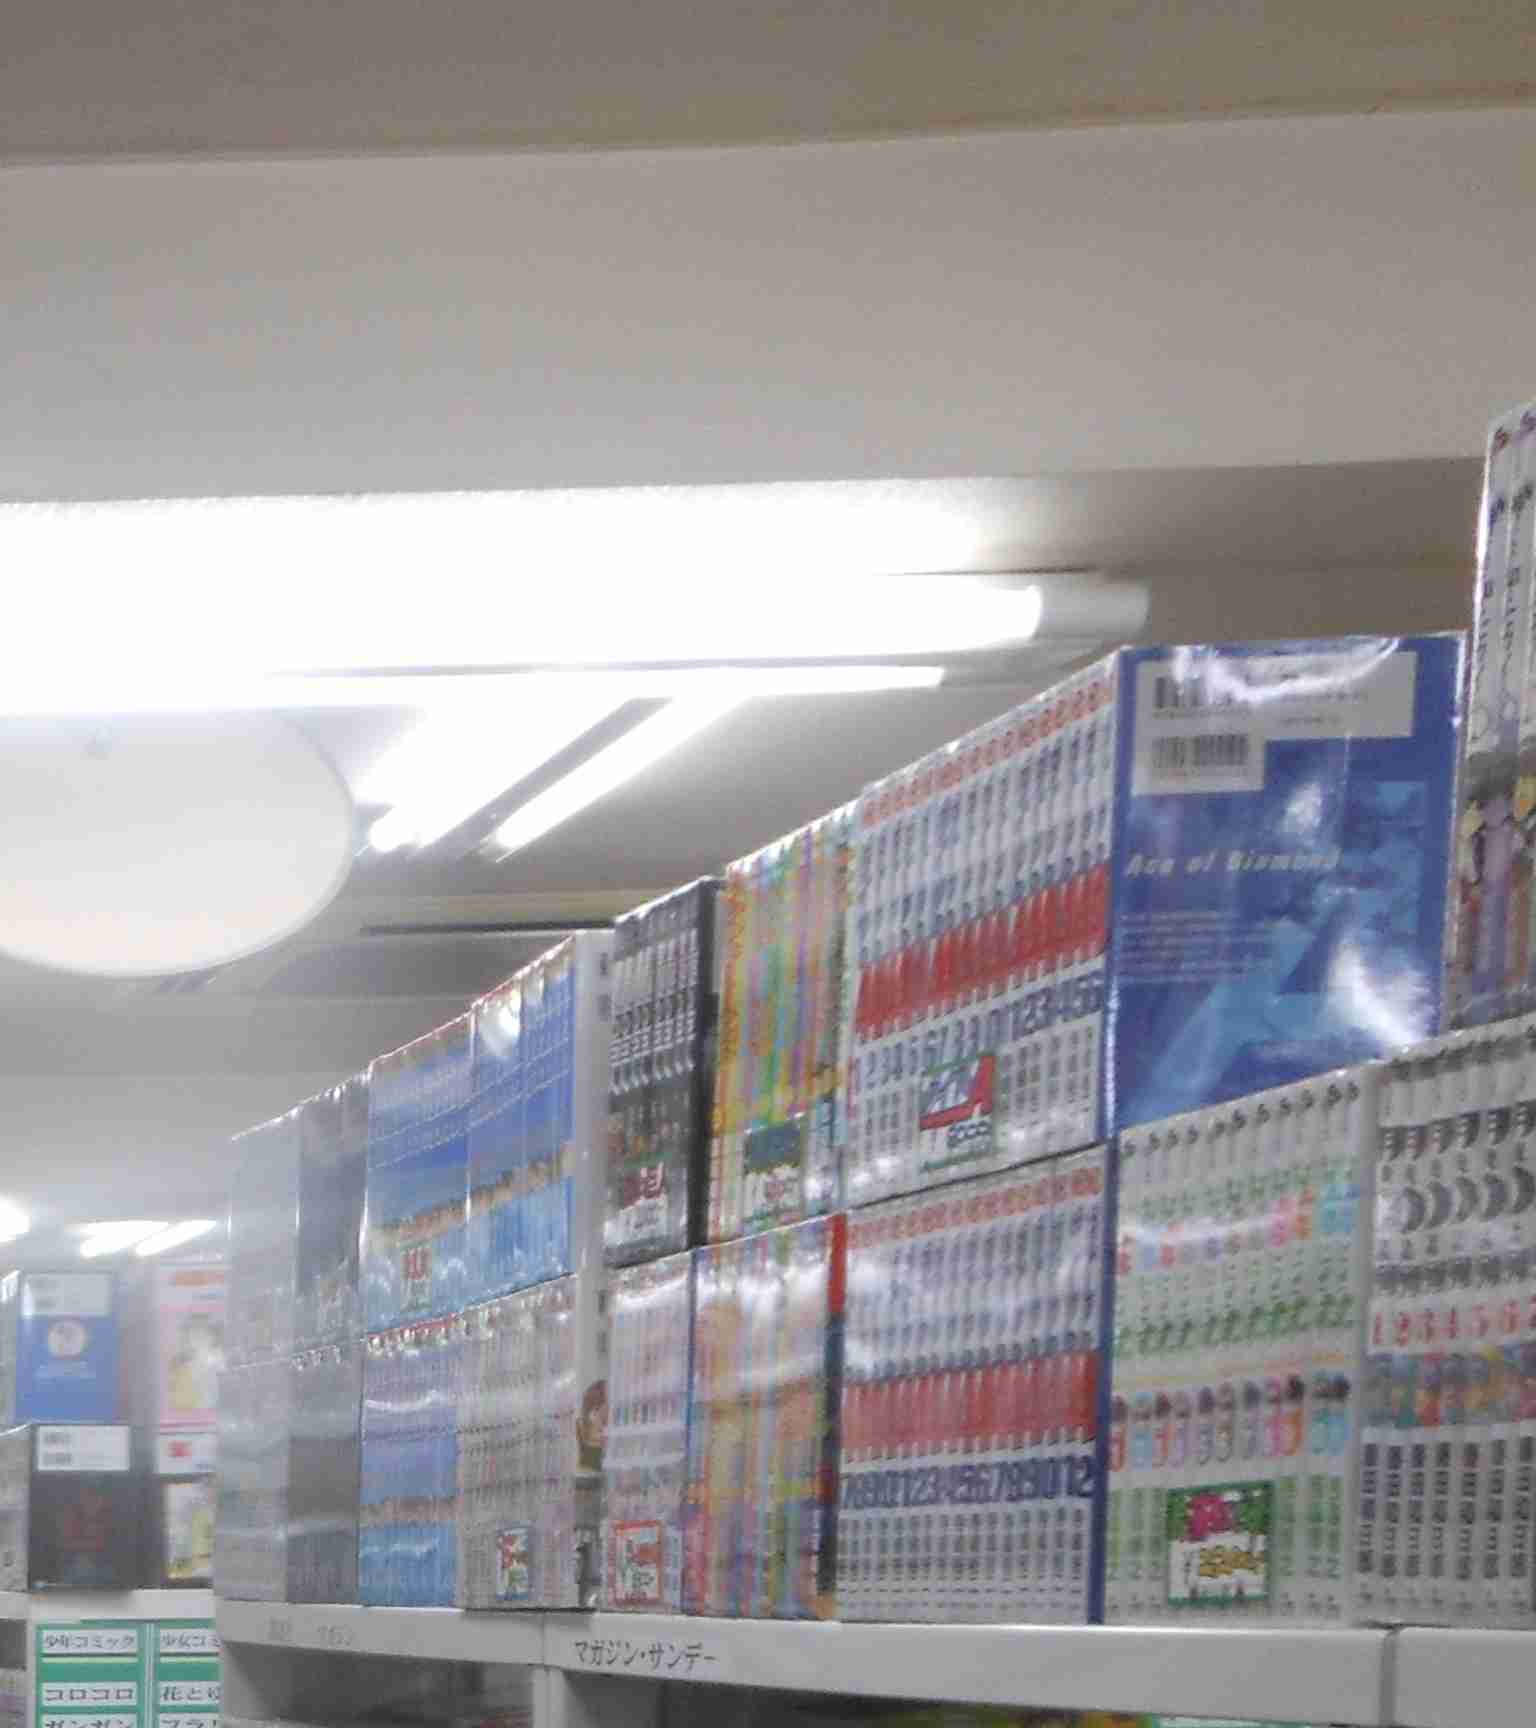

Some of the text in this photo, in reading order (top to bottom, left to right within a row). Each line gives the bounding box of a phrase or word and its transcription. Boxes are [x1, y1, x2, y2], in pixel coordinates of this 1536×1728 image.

[574, 1640, 721, 1672] マガジン・サンデー
[45, 1687, 134, 1702] コロコロ
